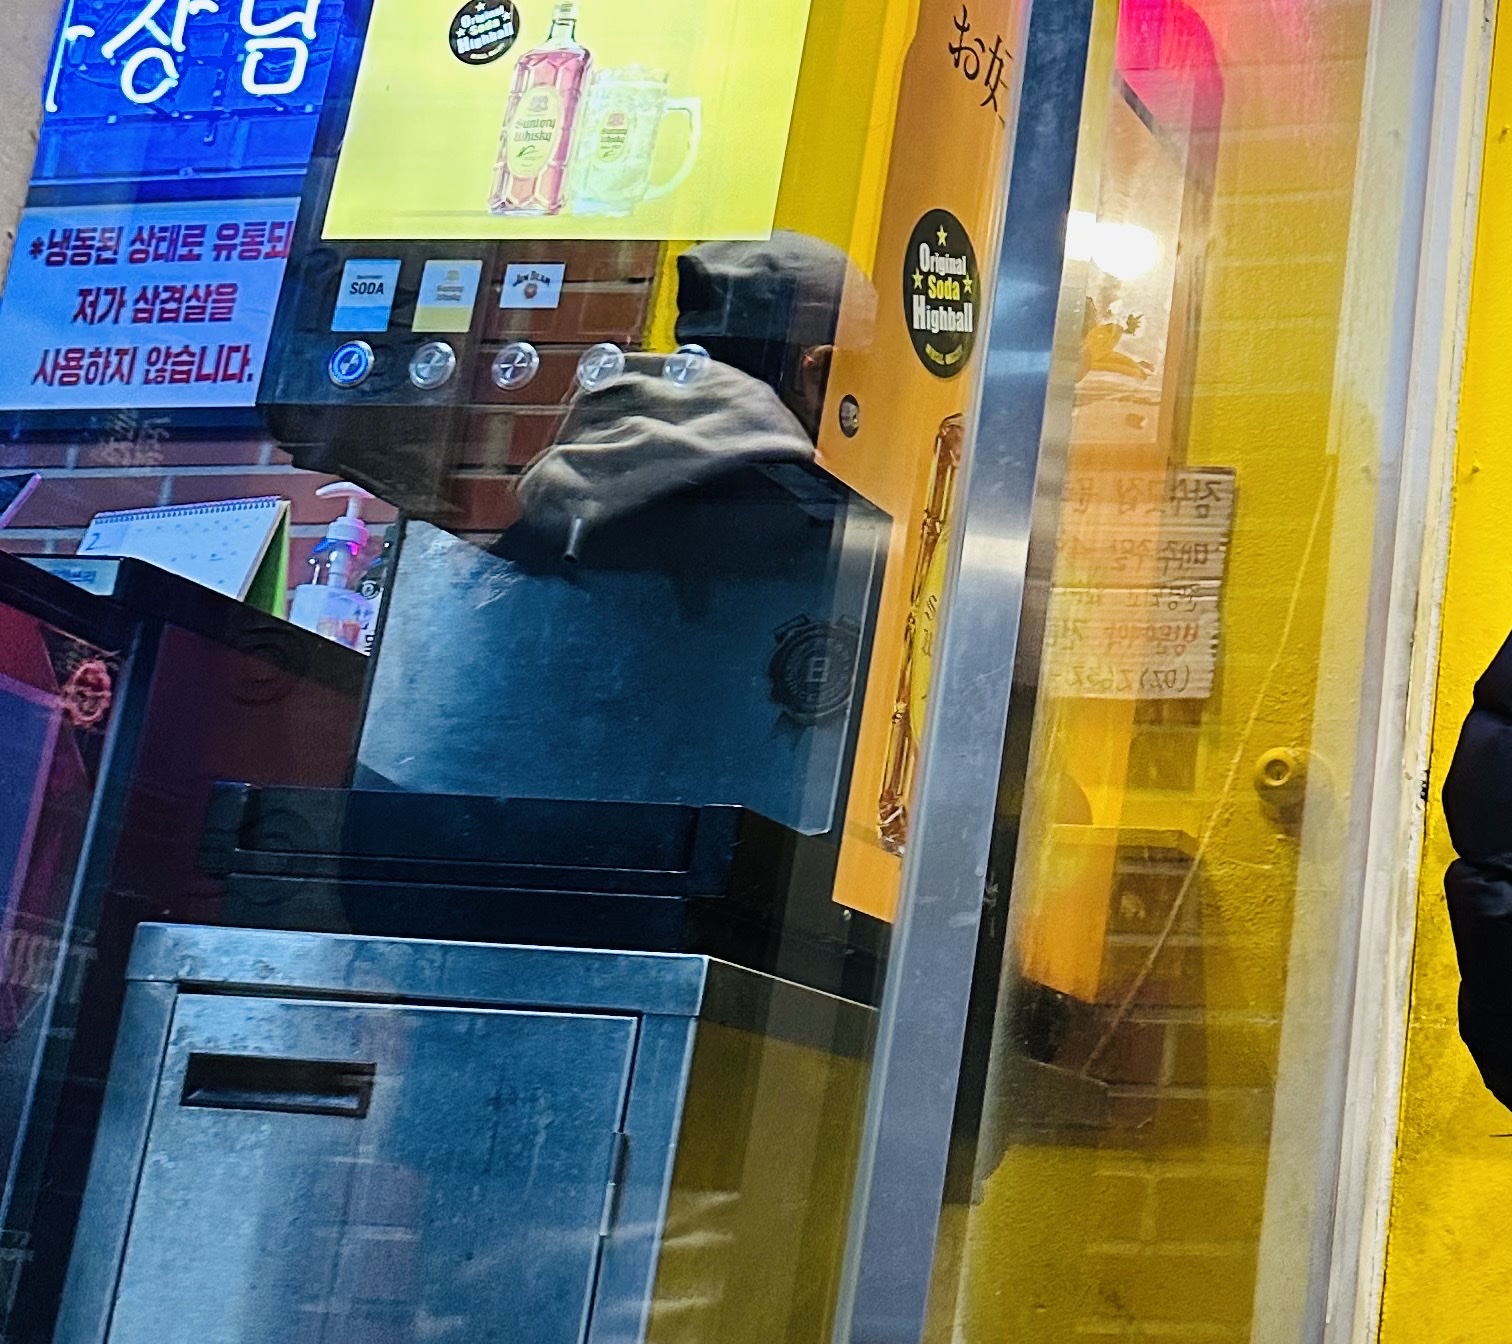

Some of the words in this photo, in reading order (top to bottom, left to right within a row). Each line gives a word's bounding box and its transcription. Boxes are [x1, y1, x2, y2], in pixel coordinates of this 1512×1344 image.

[128, 223, 208, 264] 상태로
[919, 241, 967, 277] Original
[71, 285, 127, 326] 저가
[131, 281, 238, 325] 삼겹살을
[349, 281, 385, 296] SODA
[926, 273, 961, 301] Soda
[912, 293, 974, 335] Highball
[31, 345, 139, 388] 사용하지
[141, 342, 254, 385] 않습니다.
